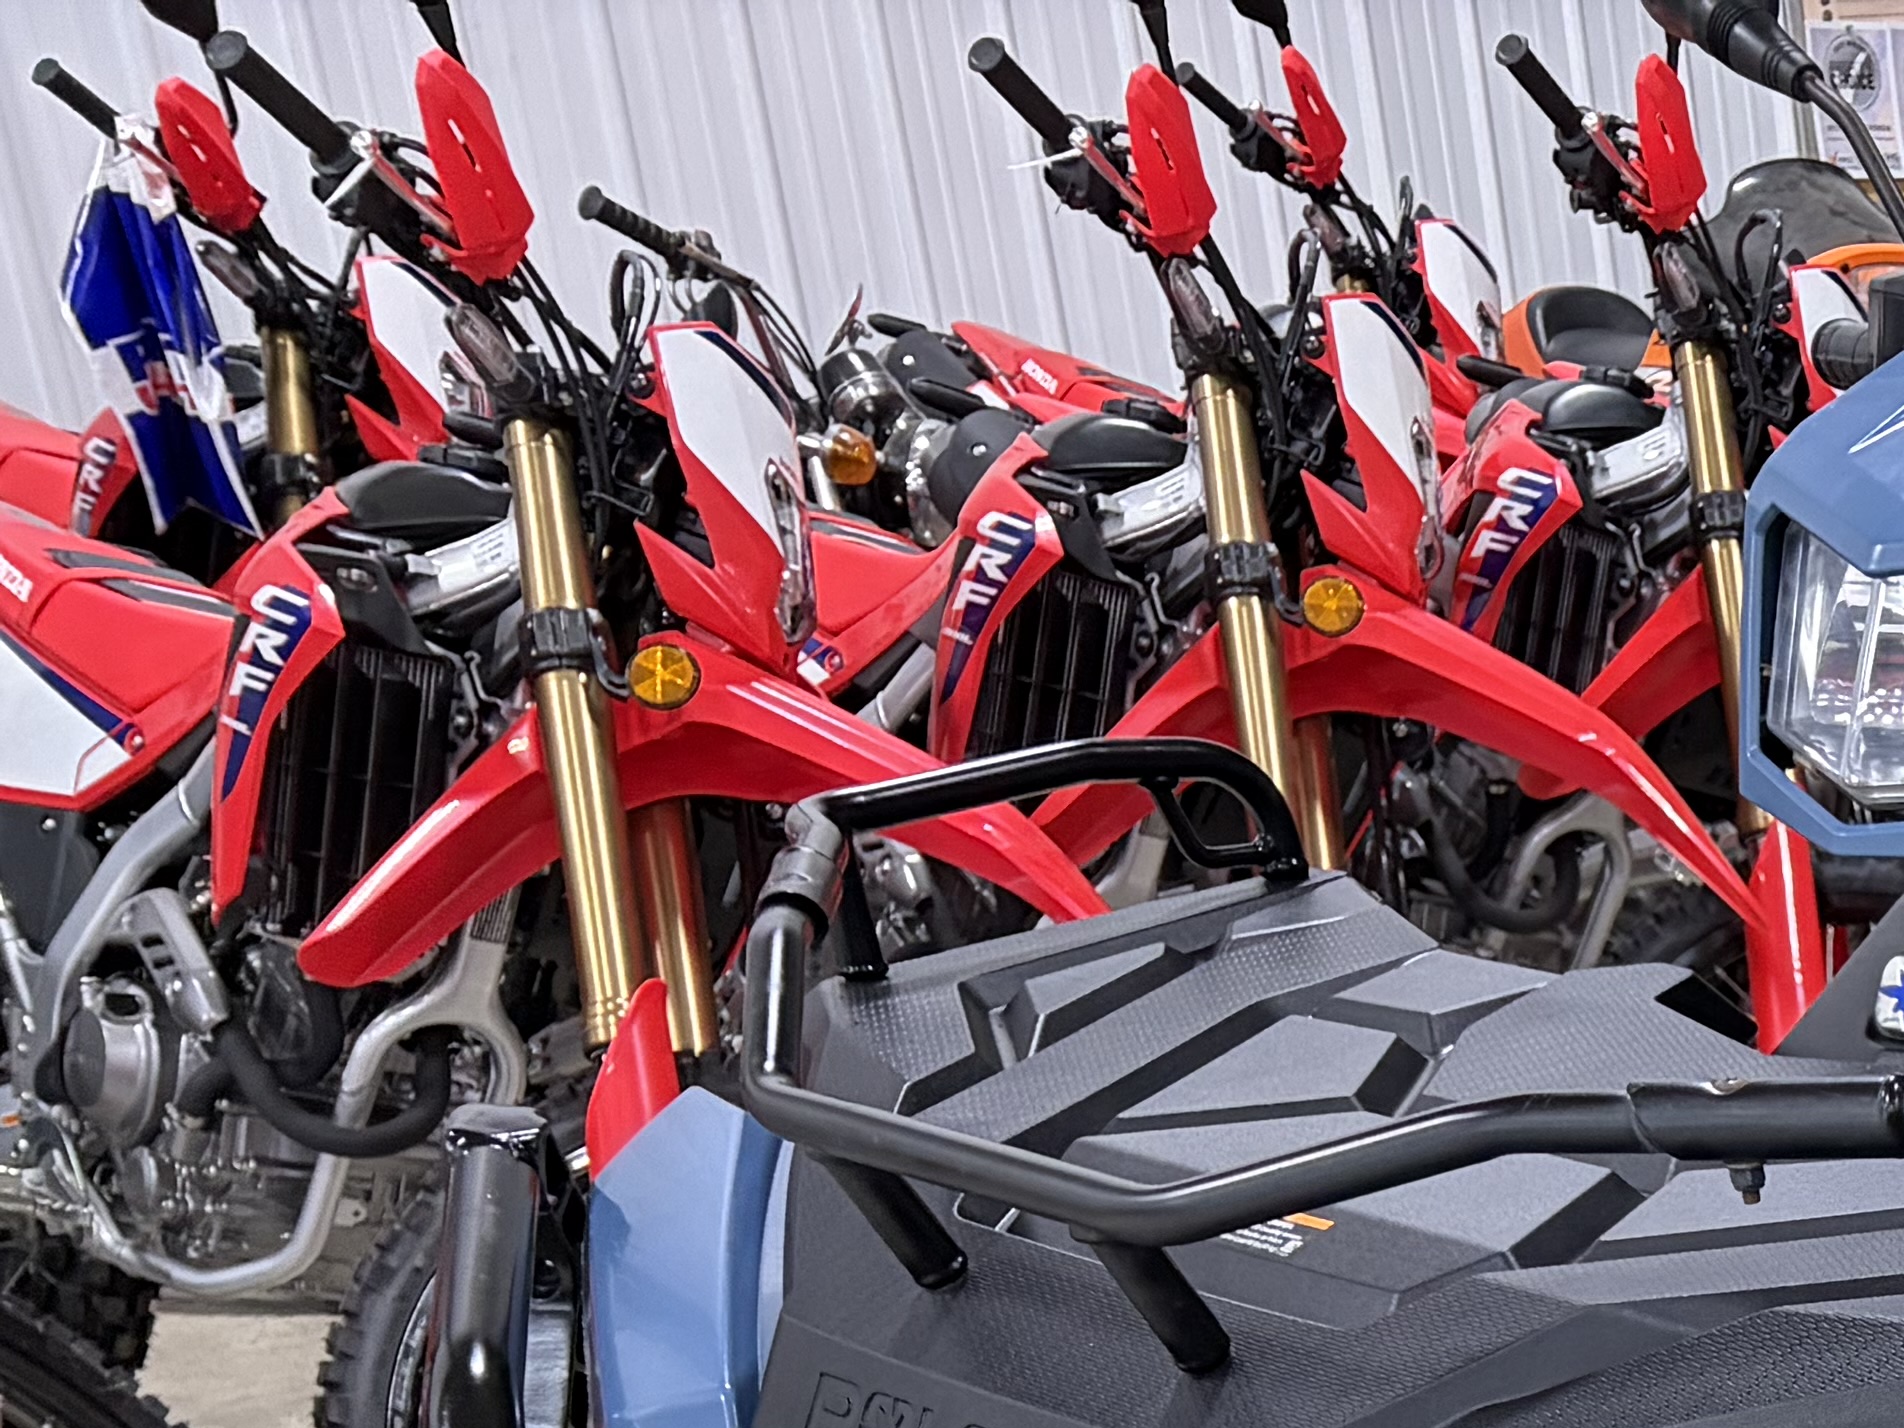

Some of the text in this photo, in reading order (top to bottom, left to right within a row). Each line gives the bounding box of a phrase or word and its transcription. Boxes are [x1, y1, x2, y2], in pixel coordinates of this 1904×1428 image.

[952, 510, 1034, 611] CRF
[1469, 466, 1553, 559] CRF
[229, 584, 309, 697] CRF
